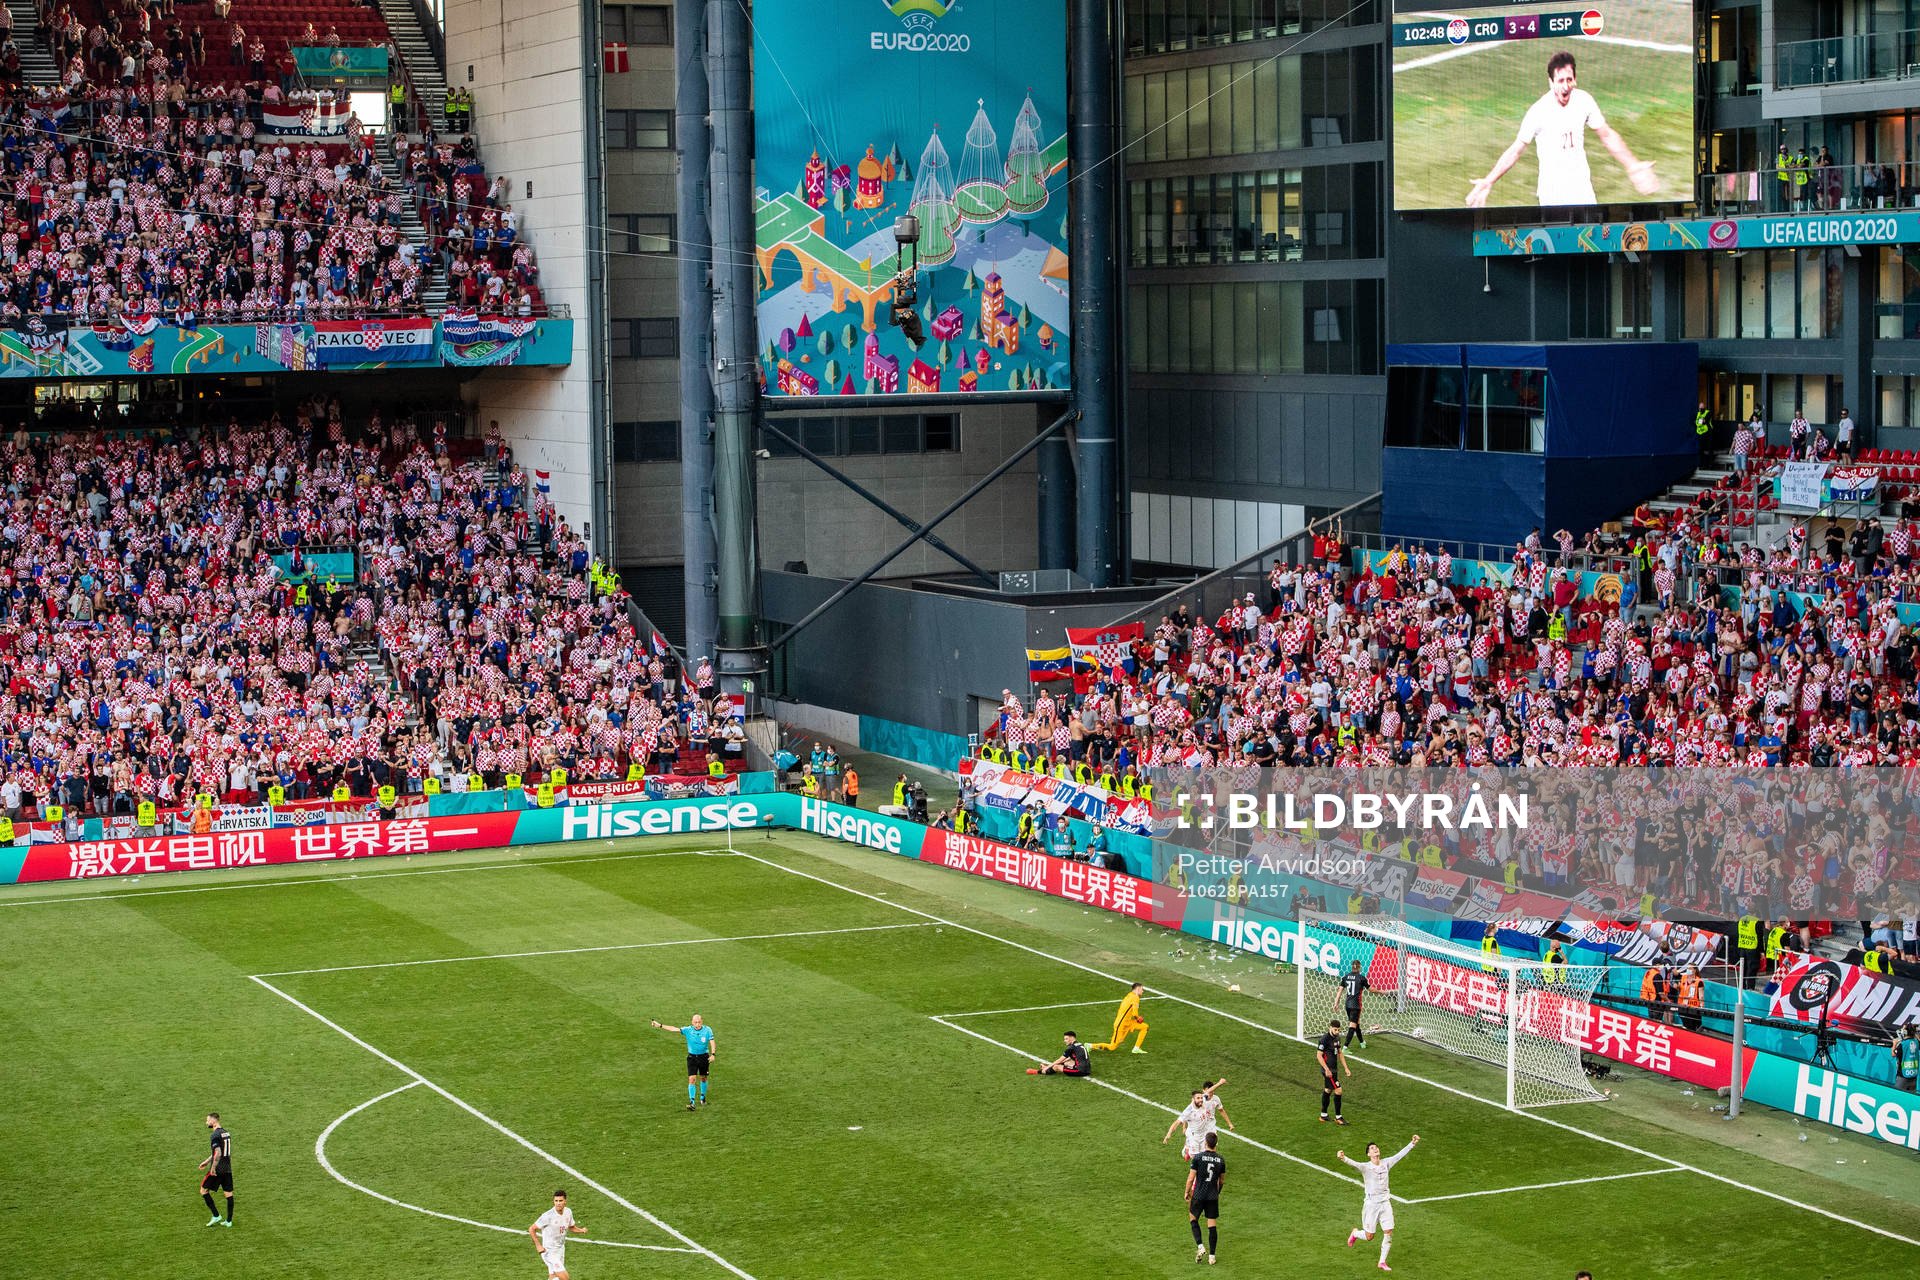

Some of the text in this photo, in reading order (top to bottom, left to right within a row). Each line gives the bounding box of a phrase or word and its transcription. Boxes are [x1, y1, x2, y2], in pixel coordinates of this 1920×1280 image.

[903, 16, 934, 30] UEFA
[1404, 26, 1445, 41] 102:48
[1474, 22, 1498, 36] CRO
[1508, 20, 1517, 34] 3
[1527, 19, 1536, 33] 4
[1549, 18, 1573, 31] ESP
[1763, 218, 1897, 243] UEFA EURO 2020
[571, 781, 641, 795] KAMEŠNICA
[219, 816, 268, 830] HRVATSKA
[562, 801, 758, 841] Hisense
[801, 797, 902, 855] Hisense
[68, 820, 479, 878] 激光电视 世界第一
[945, 832, 1165, 915] 激光电视 世界第一
[1211, 900, 1341, 977] Hisense
[1834, 974, 1904, 1022] MI
[1558, 1002, 1716, 1072] 世界第一
[1205, 1163, 1215, 1182] 5
